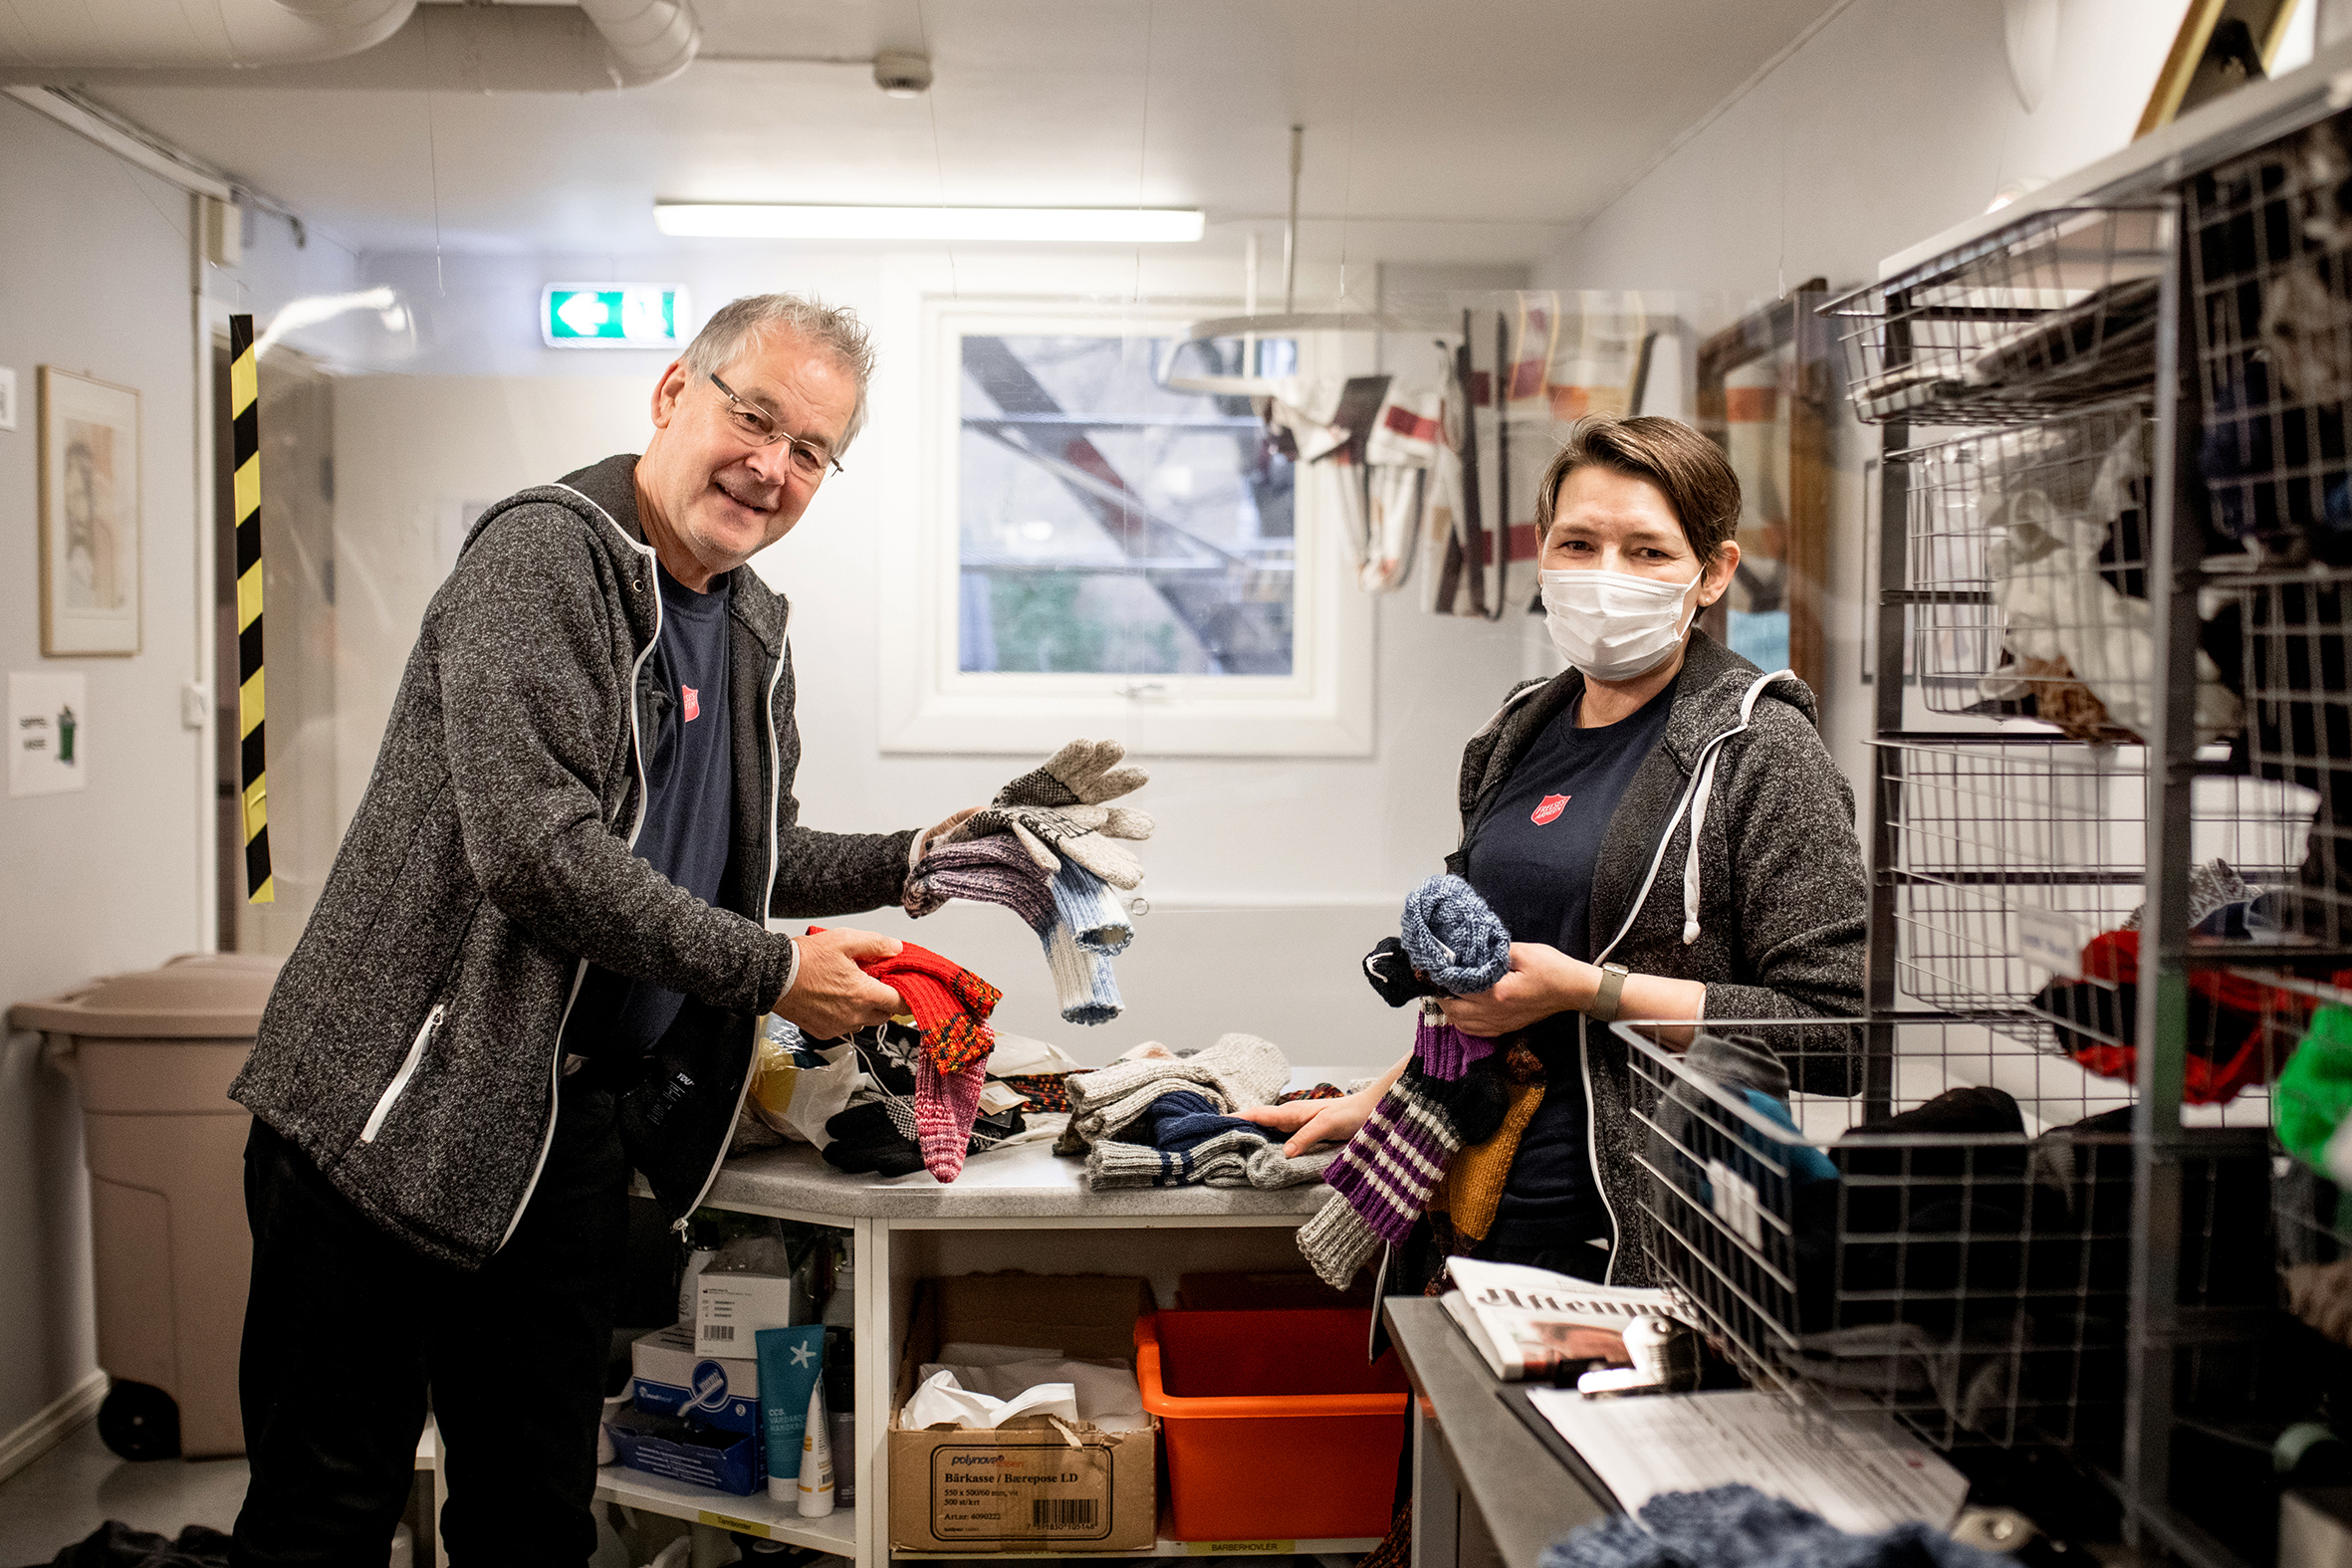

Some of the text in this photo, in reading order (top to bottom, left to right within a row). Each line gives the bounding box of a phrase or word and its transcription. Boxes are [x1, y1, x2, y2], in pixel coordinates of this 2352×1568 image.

[944, 1473, 1078, 1485] Bärkasse / Bærepose LD
